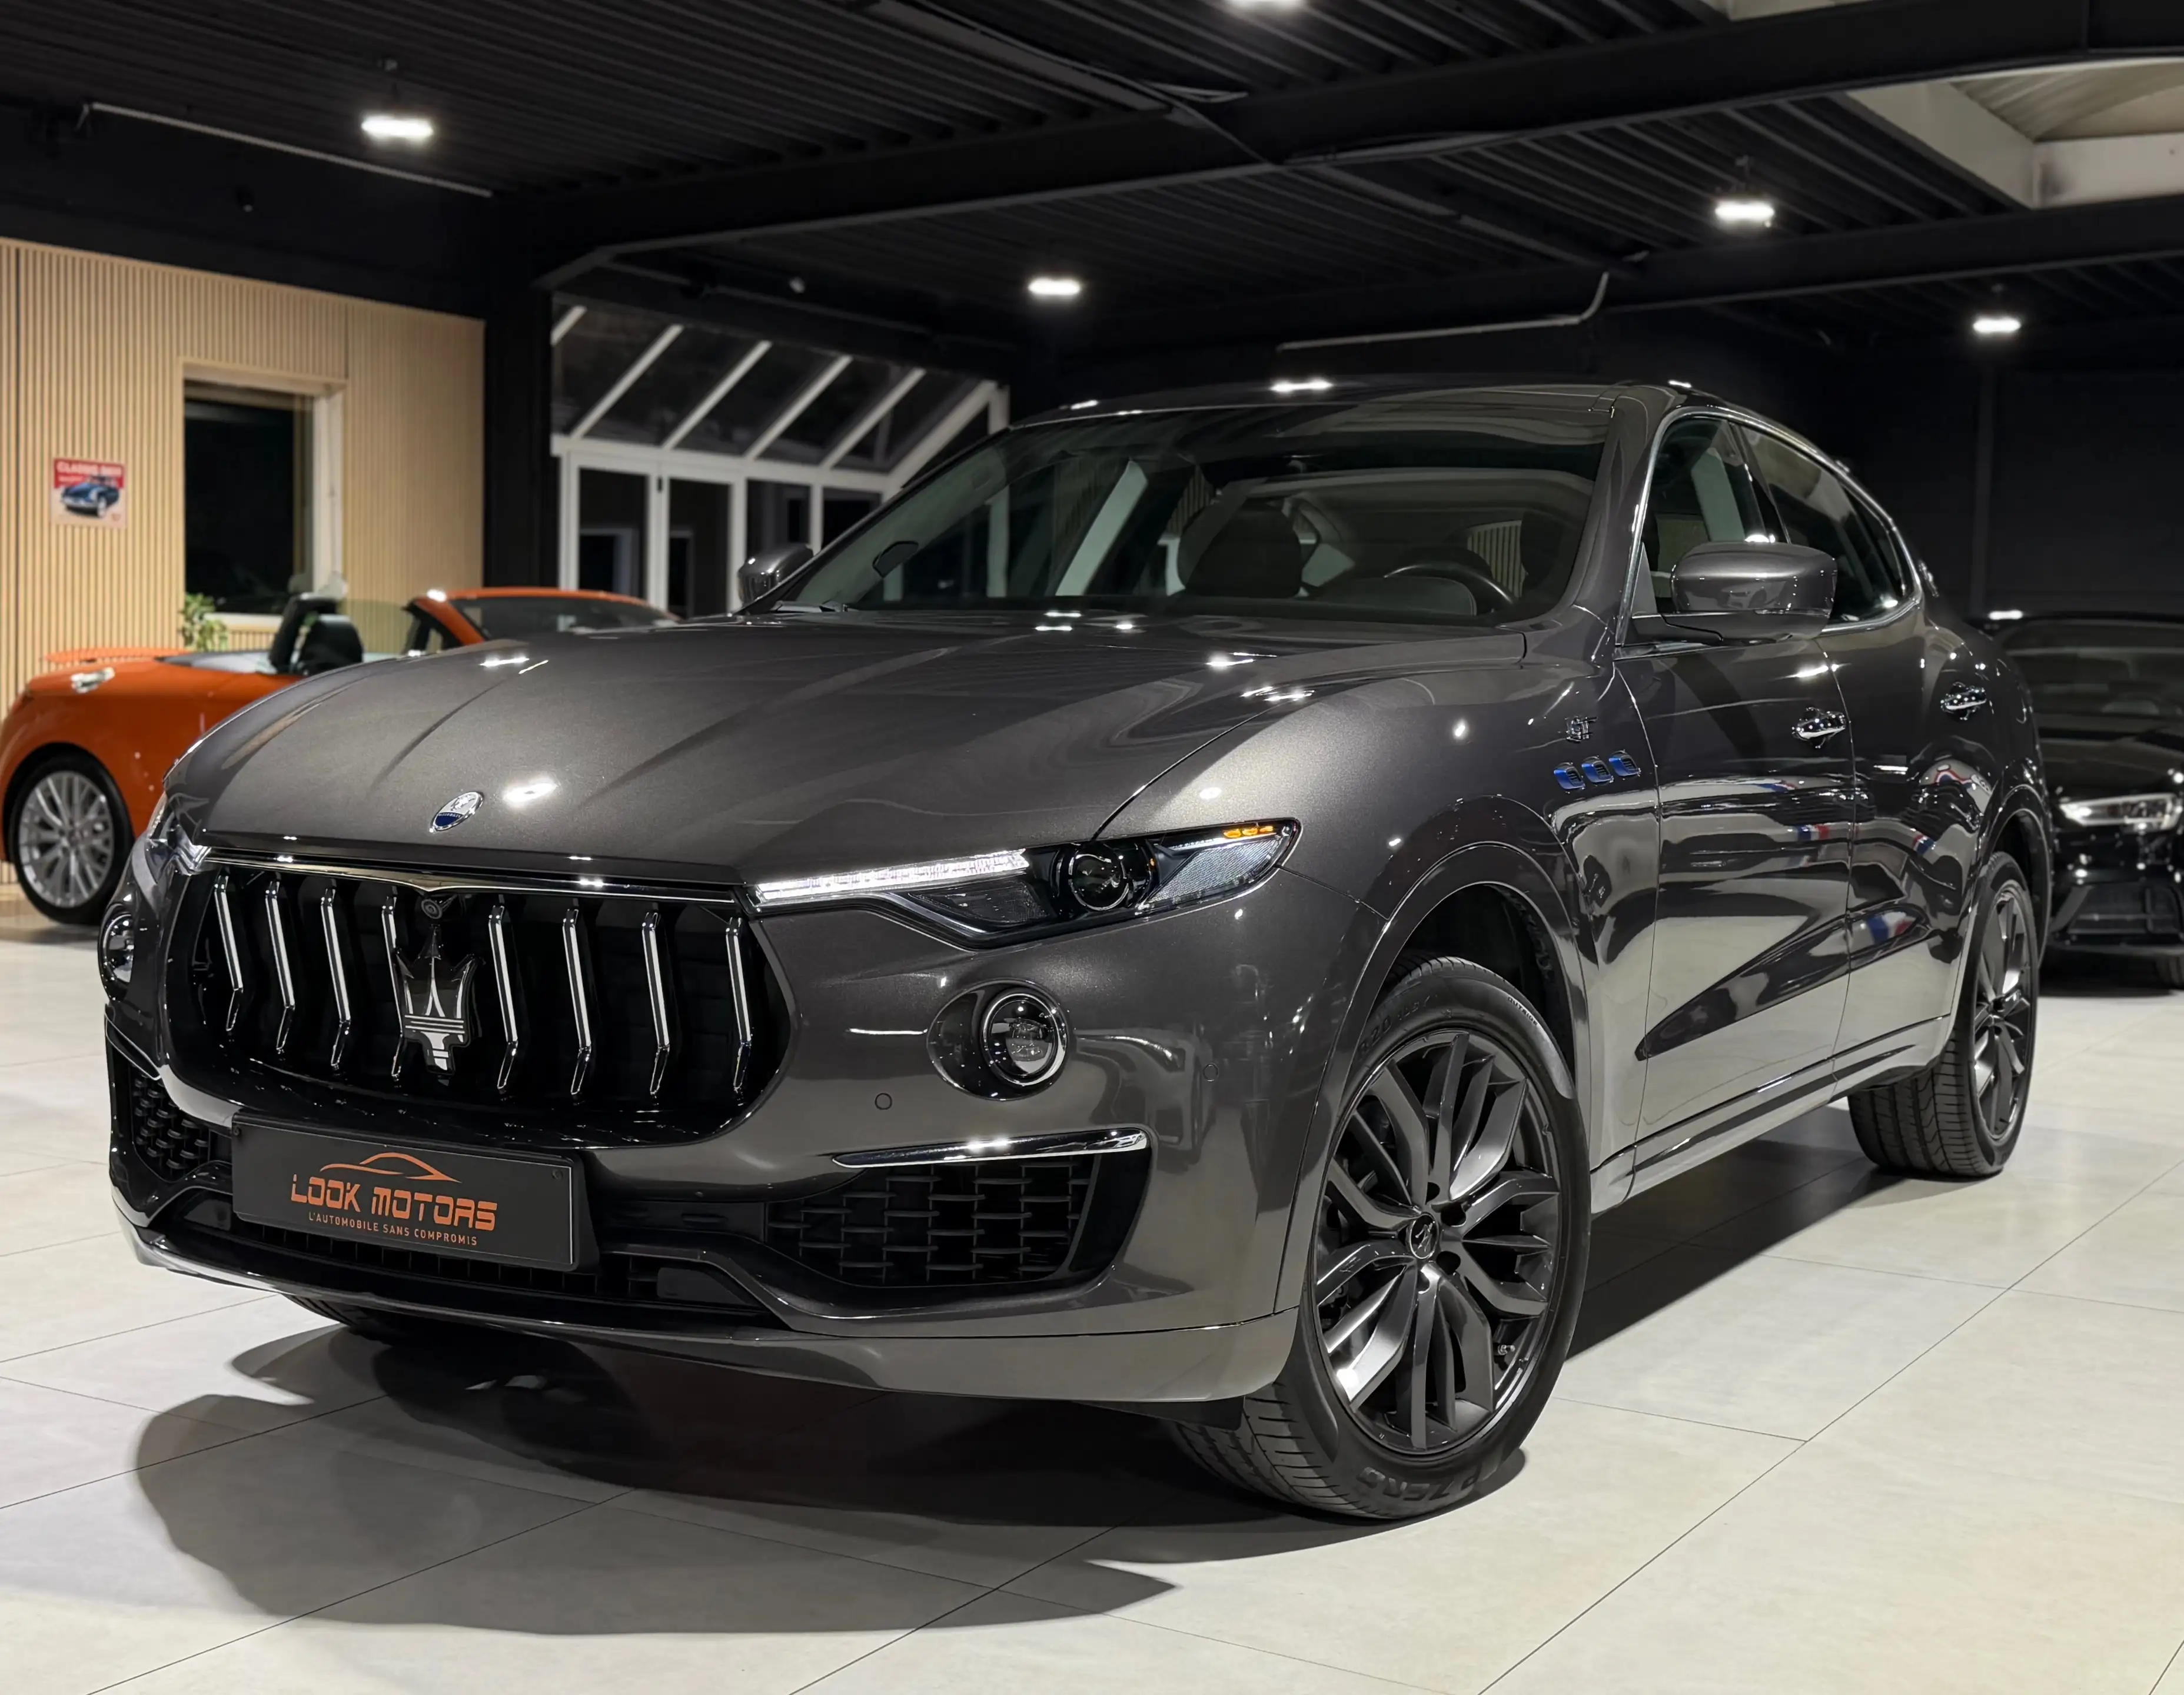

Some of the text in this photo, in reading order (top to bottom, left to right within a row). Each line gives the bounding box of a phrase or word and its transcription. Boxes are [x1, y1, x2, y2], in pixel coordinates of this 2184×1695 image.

[291, 1174, 497, 1231] LOOK MOTORS
[308, 1212, 477, 1246] L'AUTOMOBILE SANS COMPROMIS
